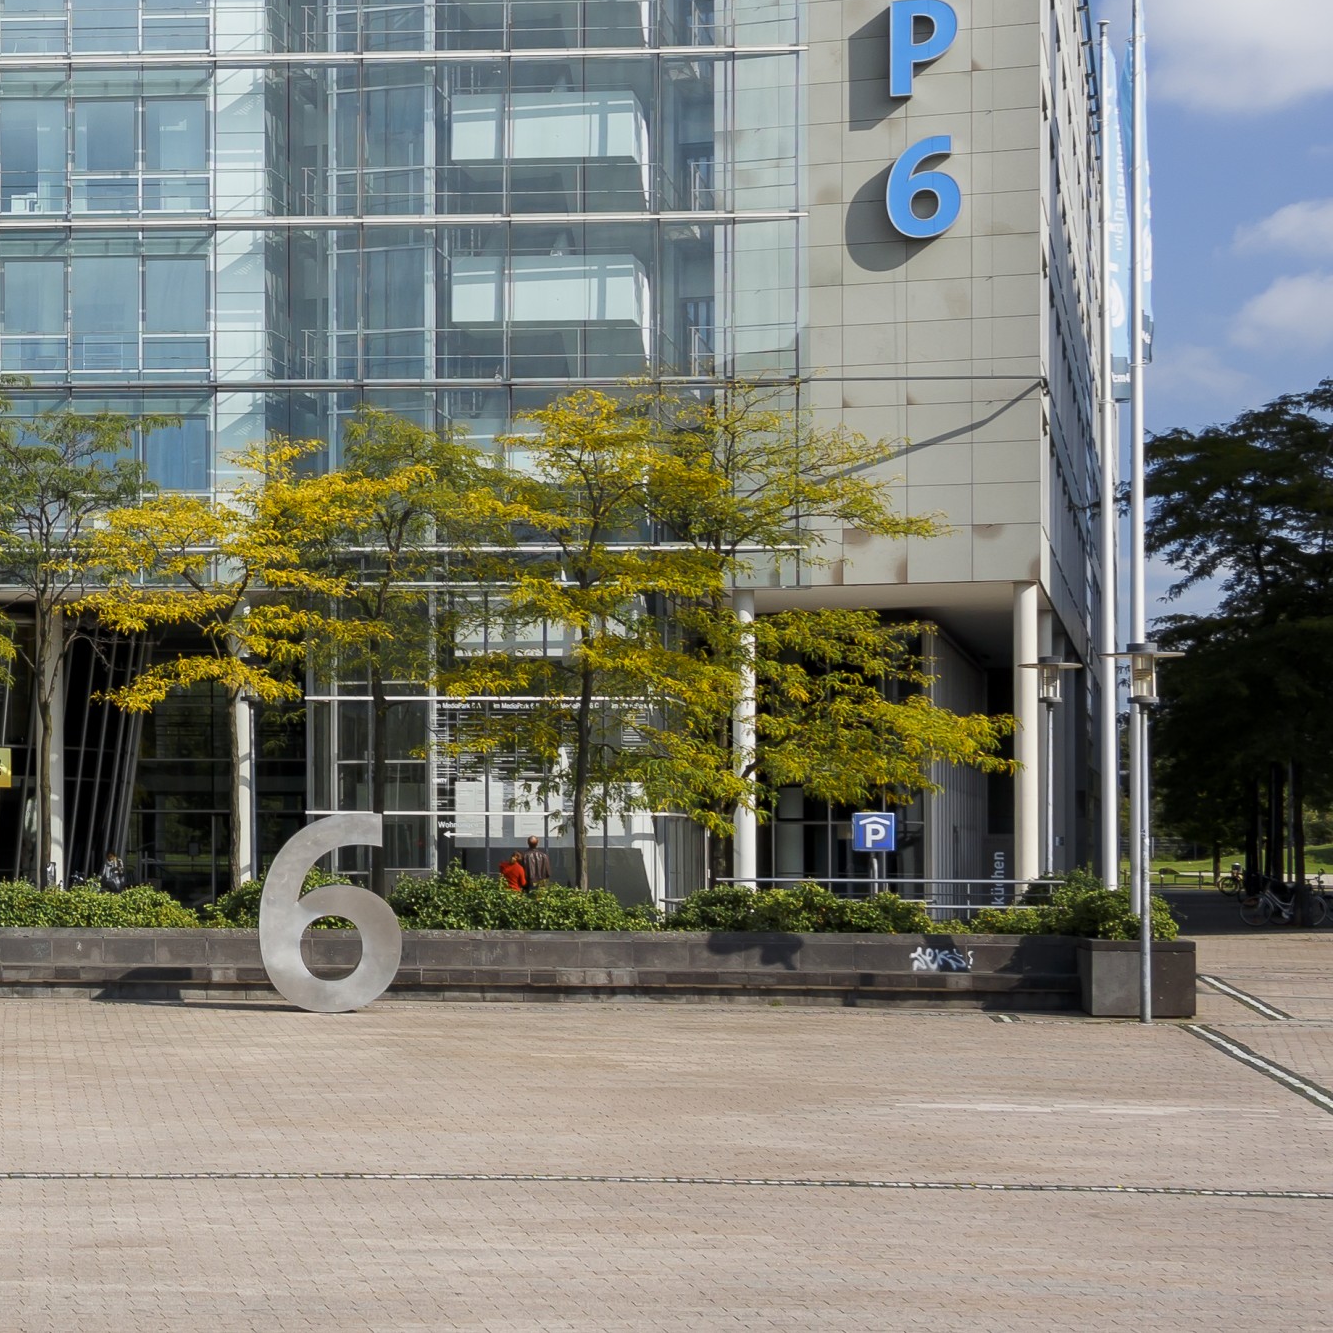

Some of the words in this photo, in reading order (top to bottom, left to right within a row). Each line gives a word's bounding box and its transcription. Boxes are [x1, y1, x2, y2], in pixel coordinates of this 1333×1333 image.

[501, 702, 530, 710] MediaPark
[866, 823, 886, 848] P
[259, 812, 402, 1013] 6
